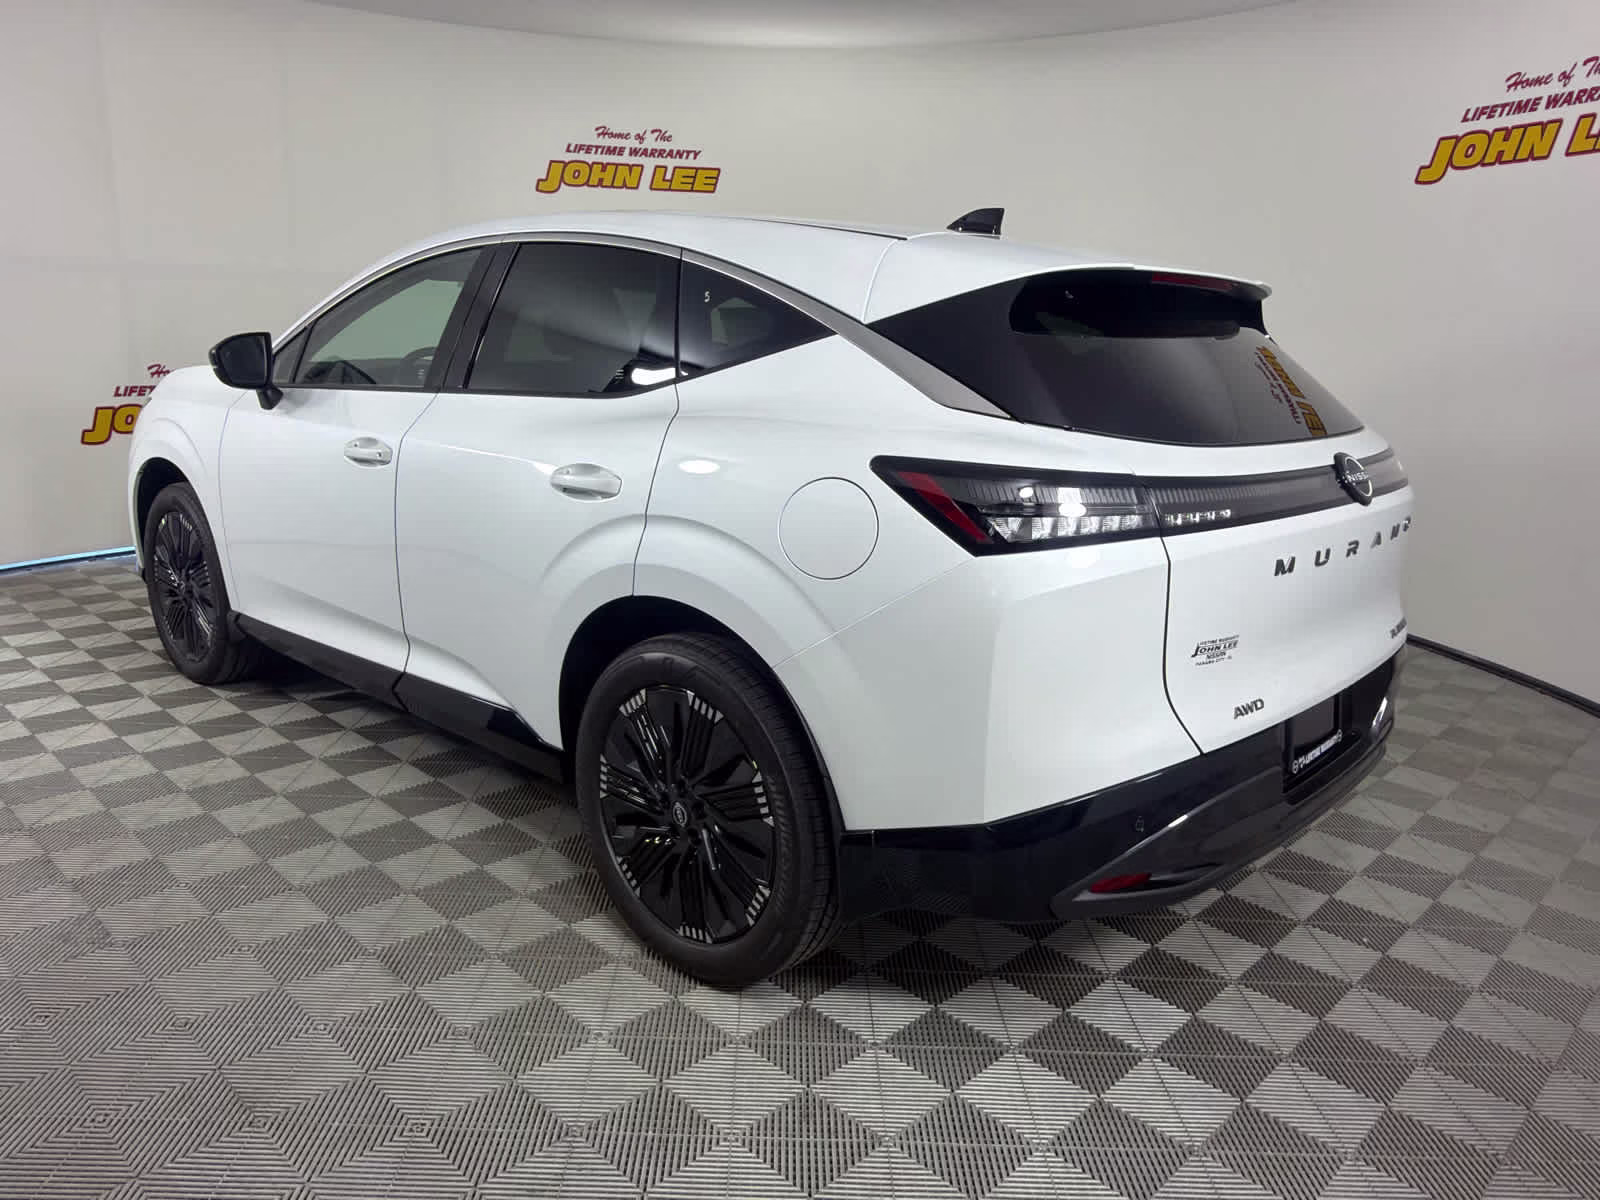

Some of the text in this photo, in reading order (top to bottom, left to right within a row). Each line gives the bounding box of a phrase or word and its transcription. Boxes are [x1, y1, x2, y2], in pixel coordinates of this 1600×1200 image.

[1505, 56, 1600, 92] Home of Th
[1461, 86, 1600, 123] LIFETIME WARR
[595, 126, 673, 144] Home of The
[565, 143, 702, 161] LIFETIME WARRANTY
[1415, 118, 1563, 185] JOHN
[536, 160, 721, 194] JOHN LEE
[704, 291, 712, 303] 5
[113, 385, 157, 397] LIFET
[81, 403, 143, 445] JO
[1274, 516, 1411, 577] MURANO
[1191, 643, 1221, 658] JOHN
[1233, 698, 1265, 720] AWD
